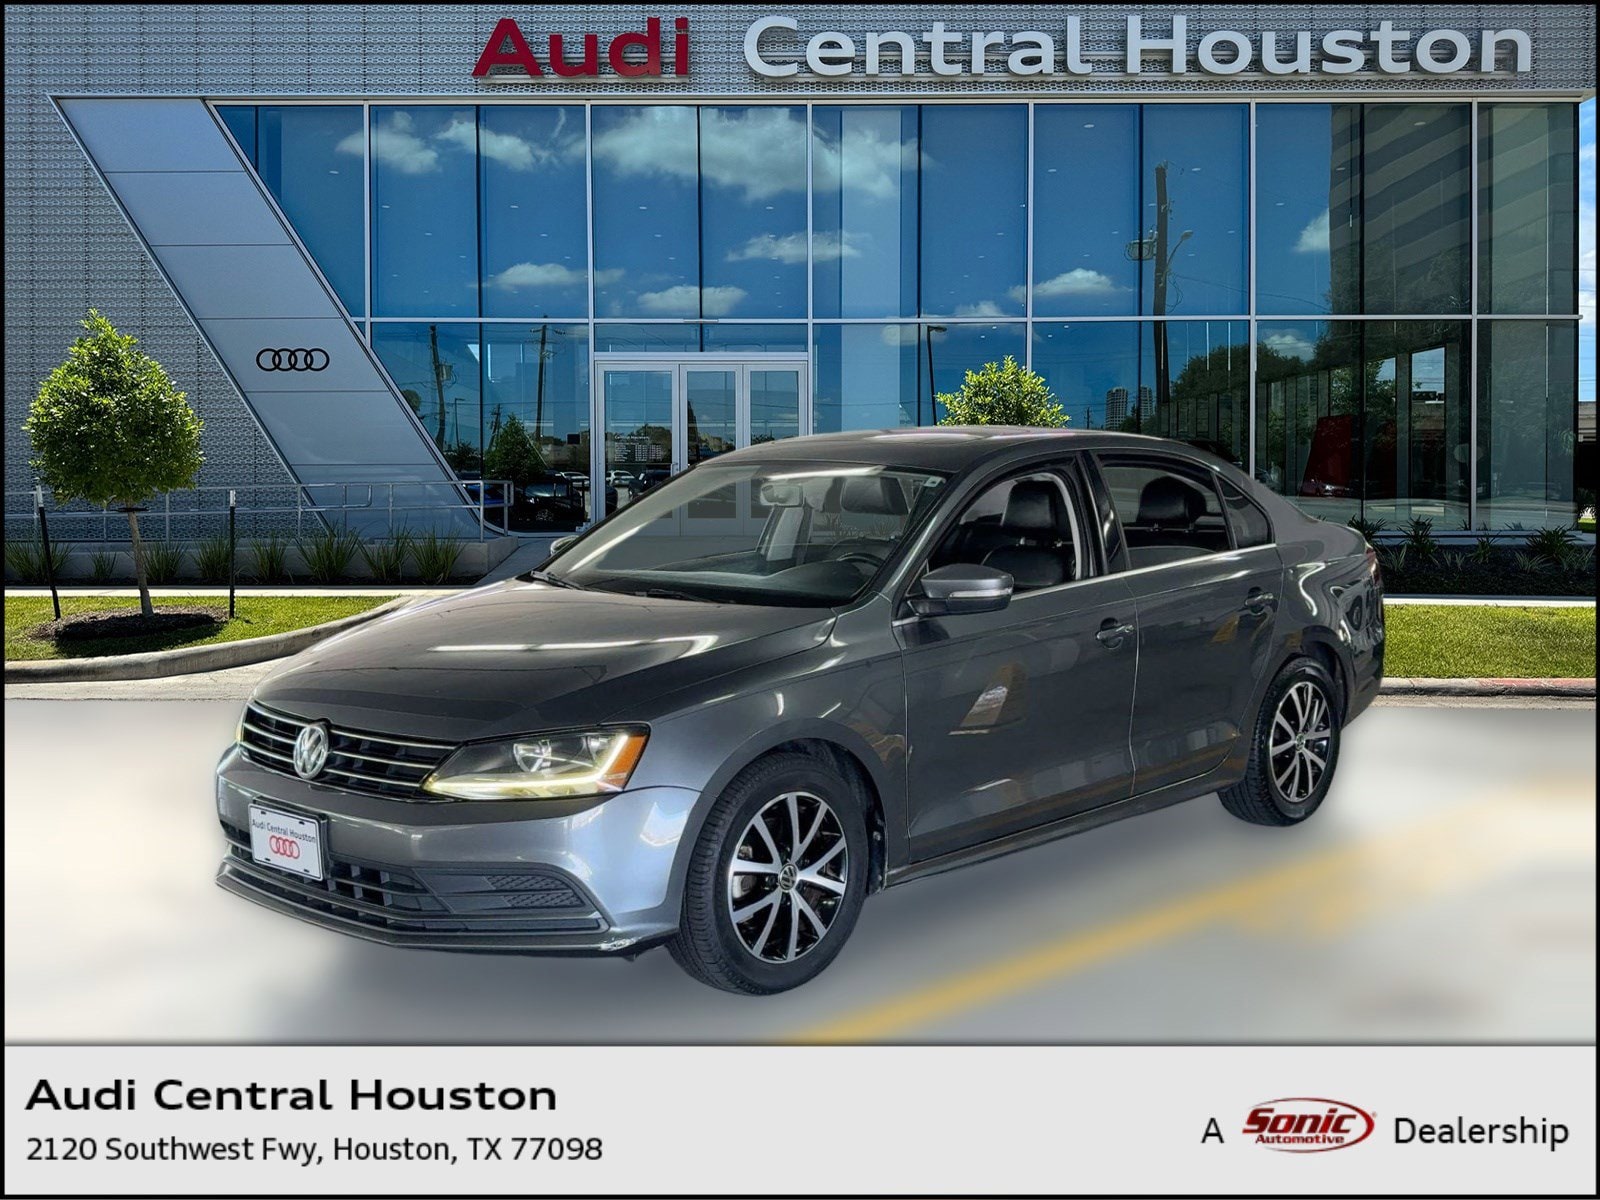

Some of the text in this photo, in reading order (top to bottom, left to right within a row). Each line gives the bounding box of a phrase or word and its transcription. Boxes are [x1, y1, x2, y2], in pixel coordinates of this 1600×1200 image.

[472, 15, 1531, 77] Audi Central Houston
[252, 818, 316, 843] Audi Central Houston
